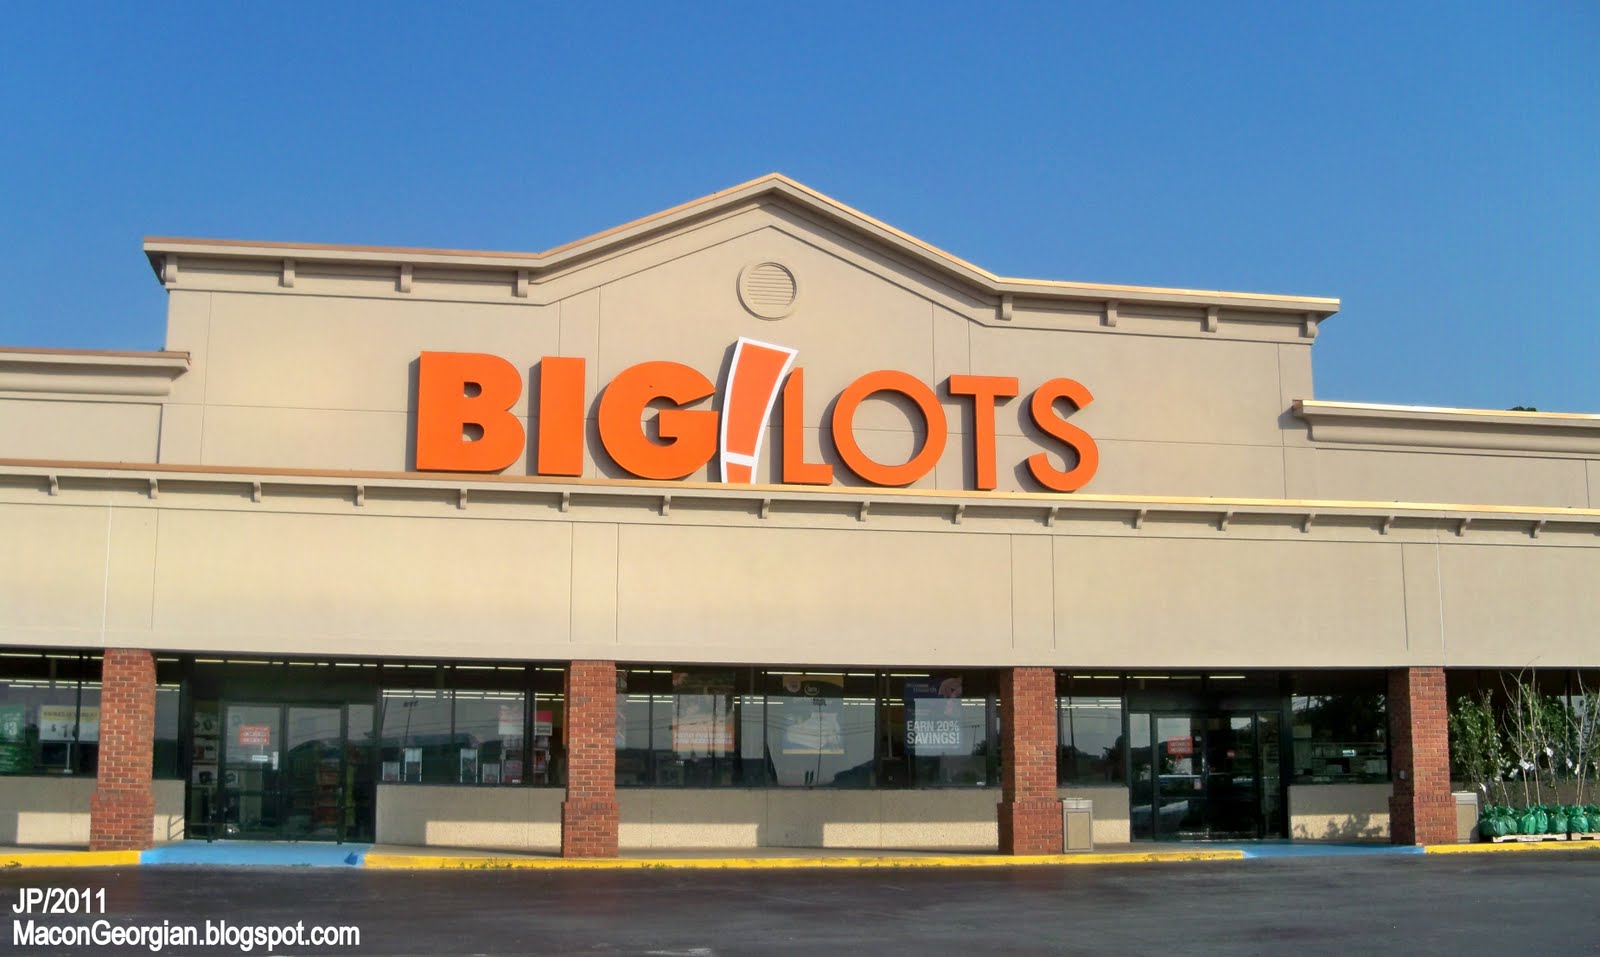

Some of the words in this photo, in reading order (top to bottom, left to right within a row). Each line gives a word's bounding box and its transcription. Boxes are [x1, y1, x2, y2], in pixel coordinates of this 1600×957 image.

[782, 366, 1099, 493] LOTS
[906, 720, 934, 732] EARN
[936, 720, 960, 732] 20%
[906, 732, 960, 745] SAVINGS!
